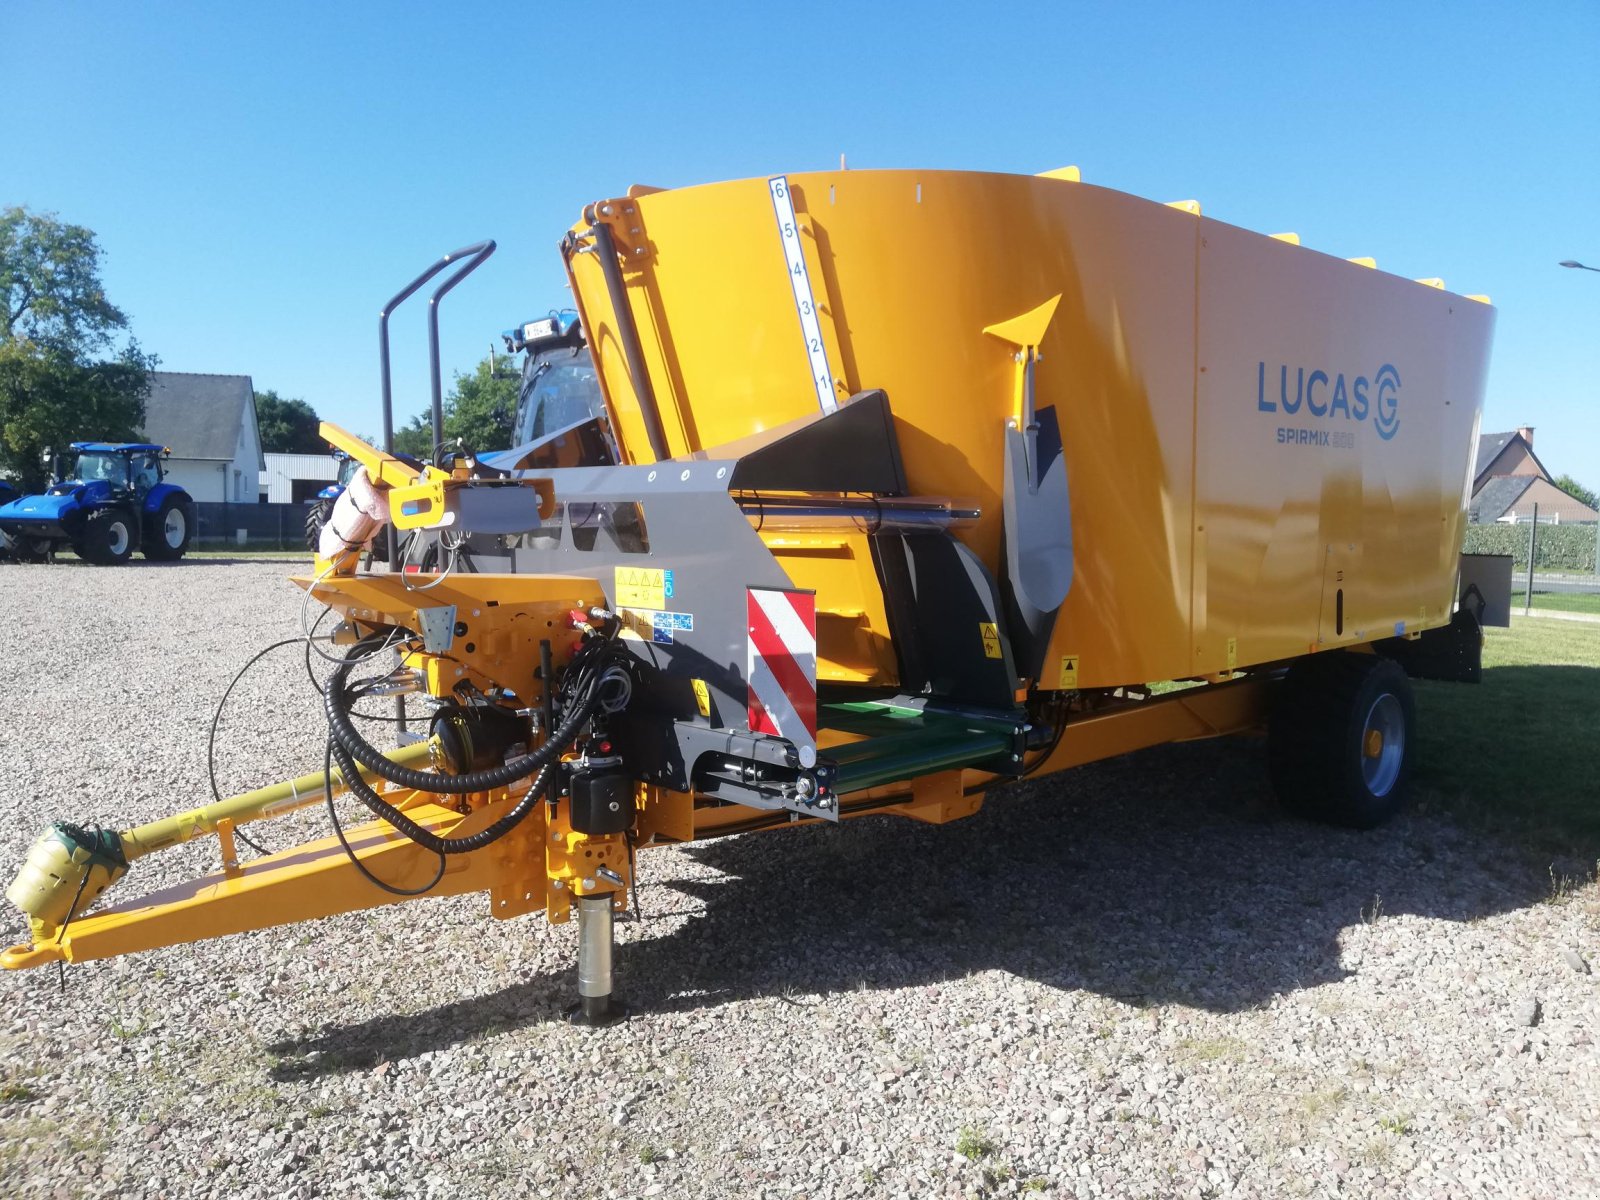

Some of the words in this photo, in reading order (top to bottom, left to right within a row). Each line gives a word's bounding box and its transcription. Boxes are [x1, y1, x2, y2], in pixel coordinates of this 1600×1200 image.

[775, 183, 784, 198] 6
[784, 223, 793, 238] 5
[793, 262, 802, 277] 4
[802, 301, 811, 315] 3
[811, 338, 820, 353] 2
[820, 375, 828, 389] 1
[1258, 361, 1369, 421] LUCAS
[1277, 427, 1330, 446] SPIRMIX
